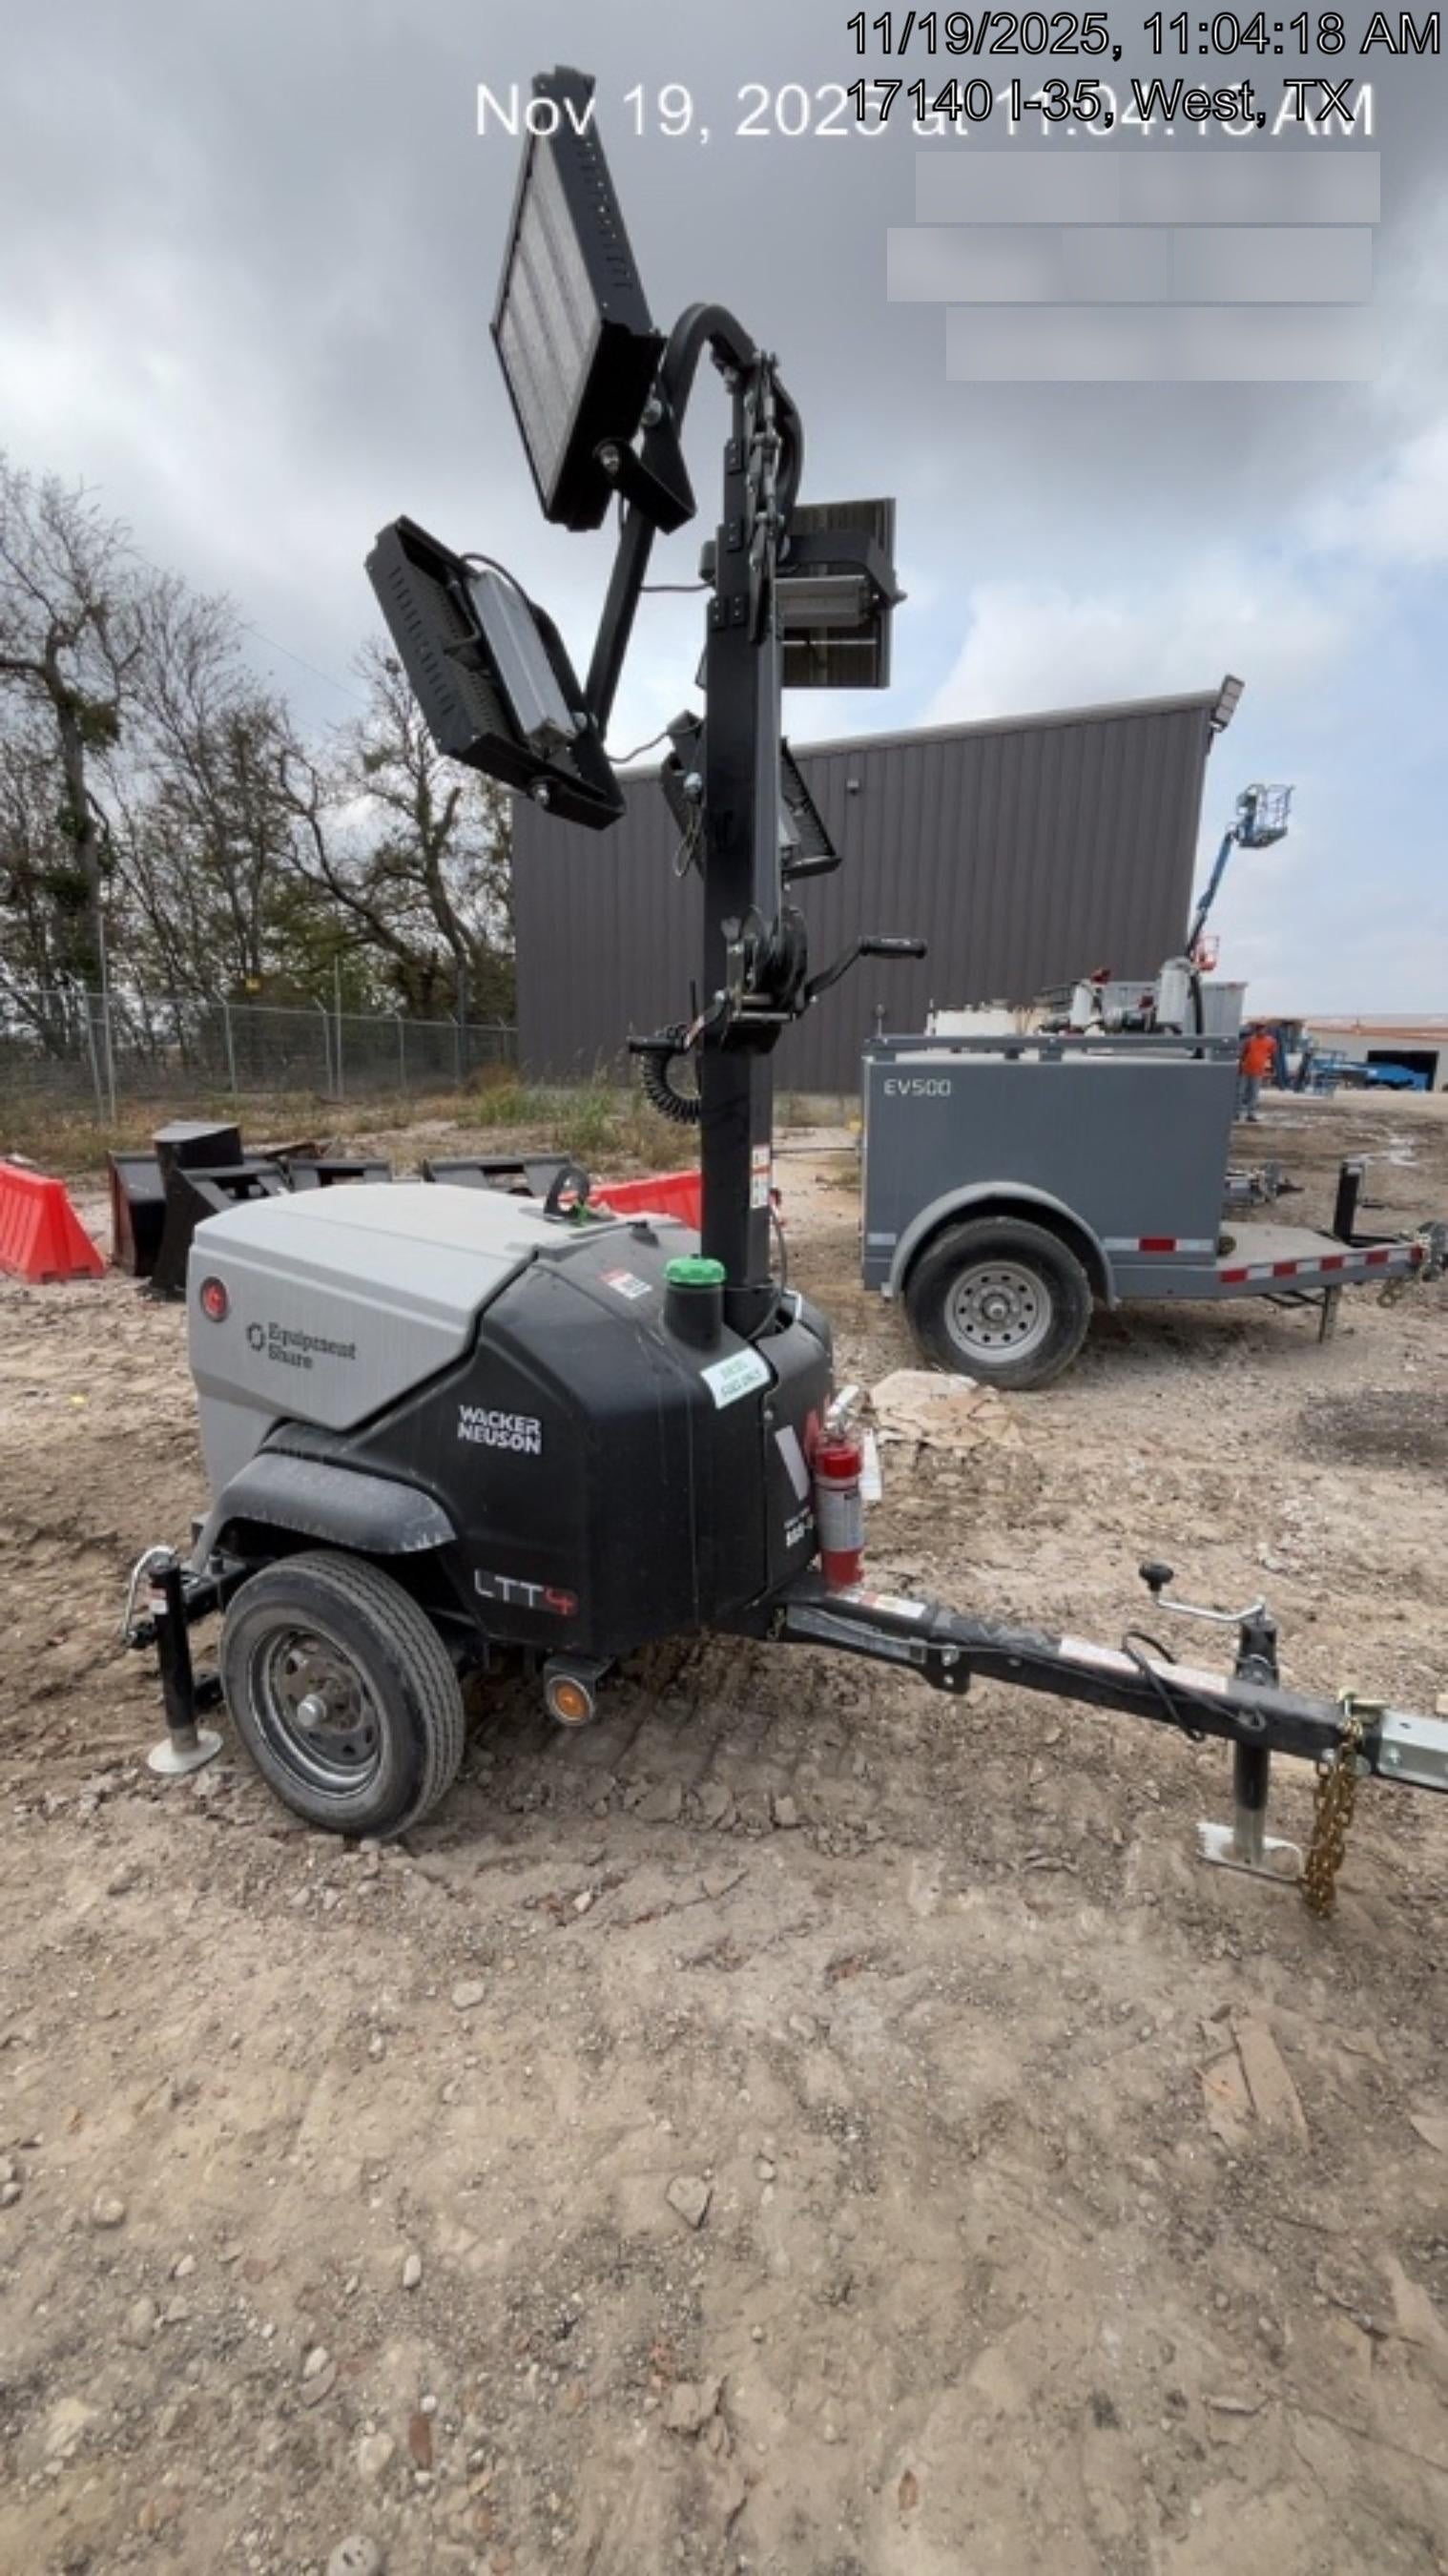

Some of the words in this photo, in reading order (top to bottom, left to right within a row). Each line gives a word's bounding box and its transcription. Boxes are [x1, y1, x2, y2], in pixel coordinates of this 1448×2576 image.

[883, 1078, 952, 1096] EV500
[268, 1321, 356, 1361] Equipment
[459, 1404, 541, 1436] WACKER
[457, 1422, 542, 1455] NEUSON
[473, 1568, 576, 1615] LTT4
